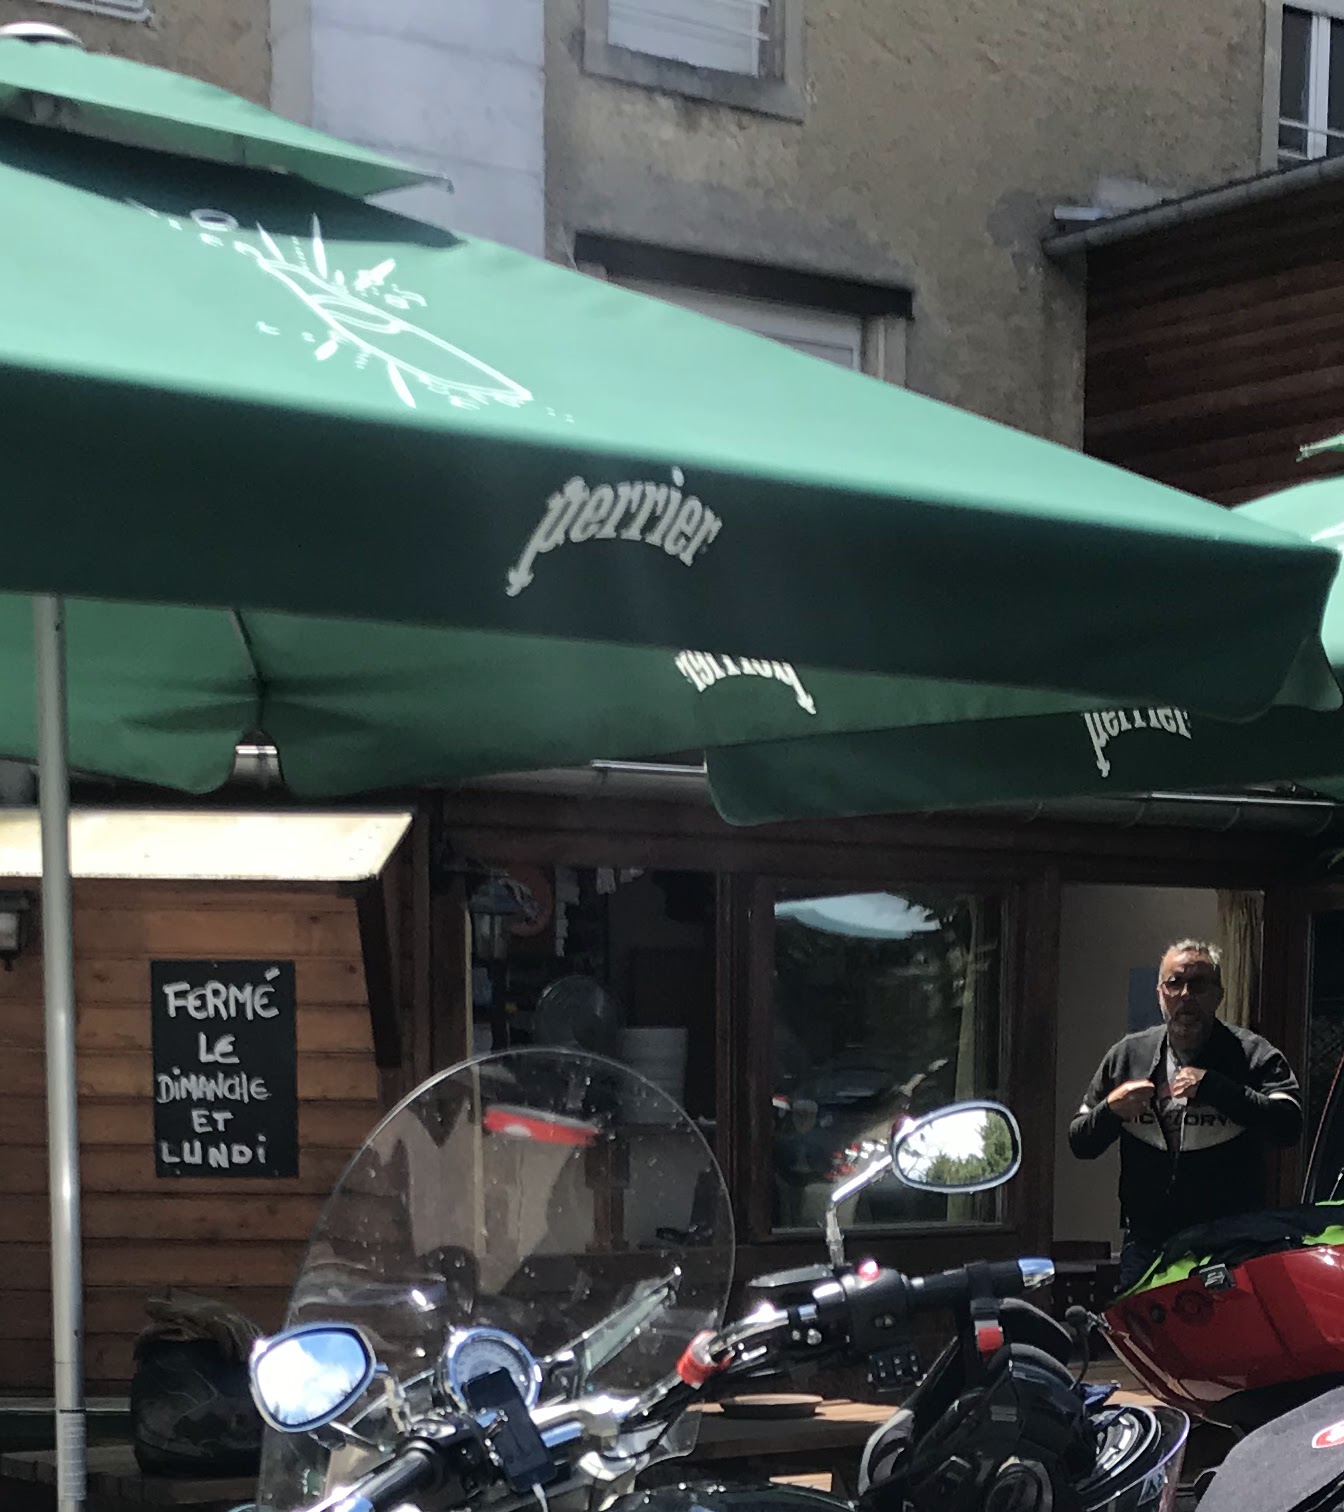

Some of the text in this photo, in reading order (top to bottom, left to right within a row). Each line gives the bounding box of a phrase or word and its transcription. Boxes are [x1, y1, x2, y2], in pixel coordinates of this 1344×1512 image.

[161, 967, 281, 1021] FERMÉ
[198, 1031, 240, 1064] LE
[191, 1108, 234, 1133] ET
